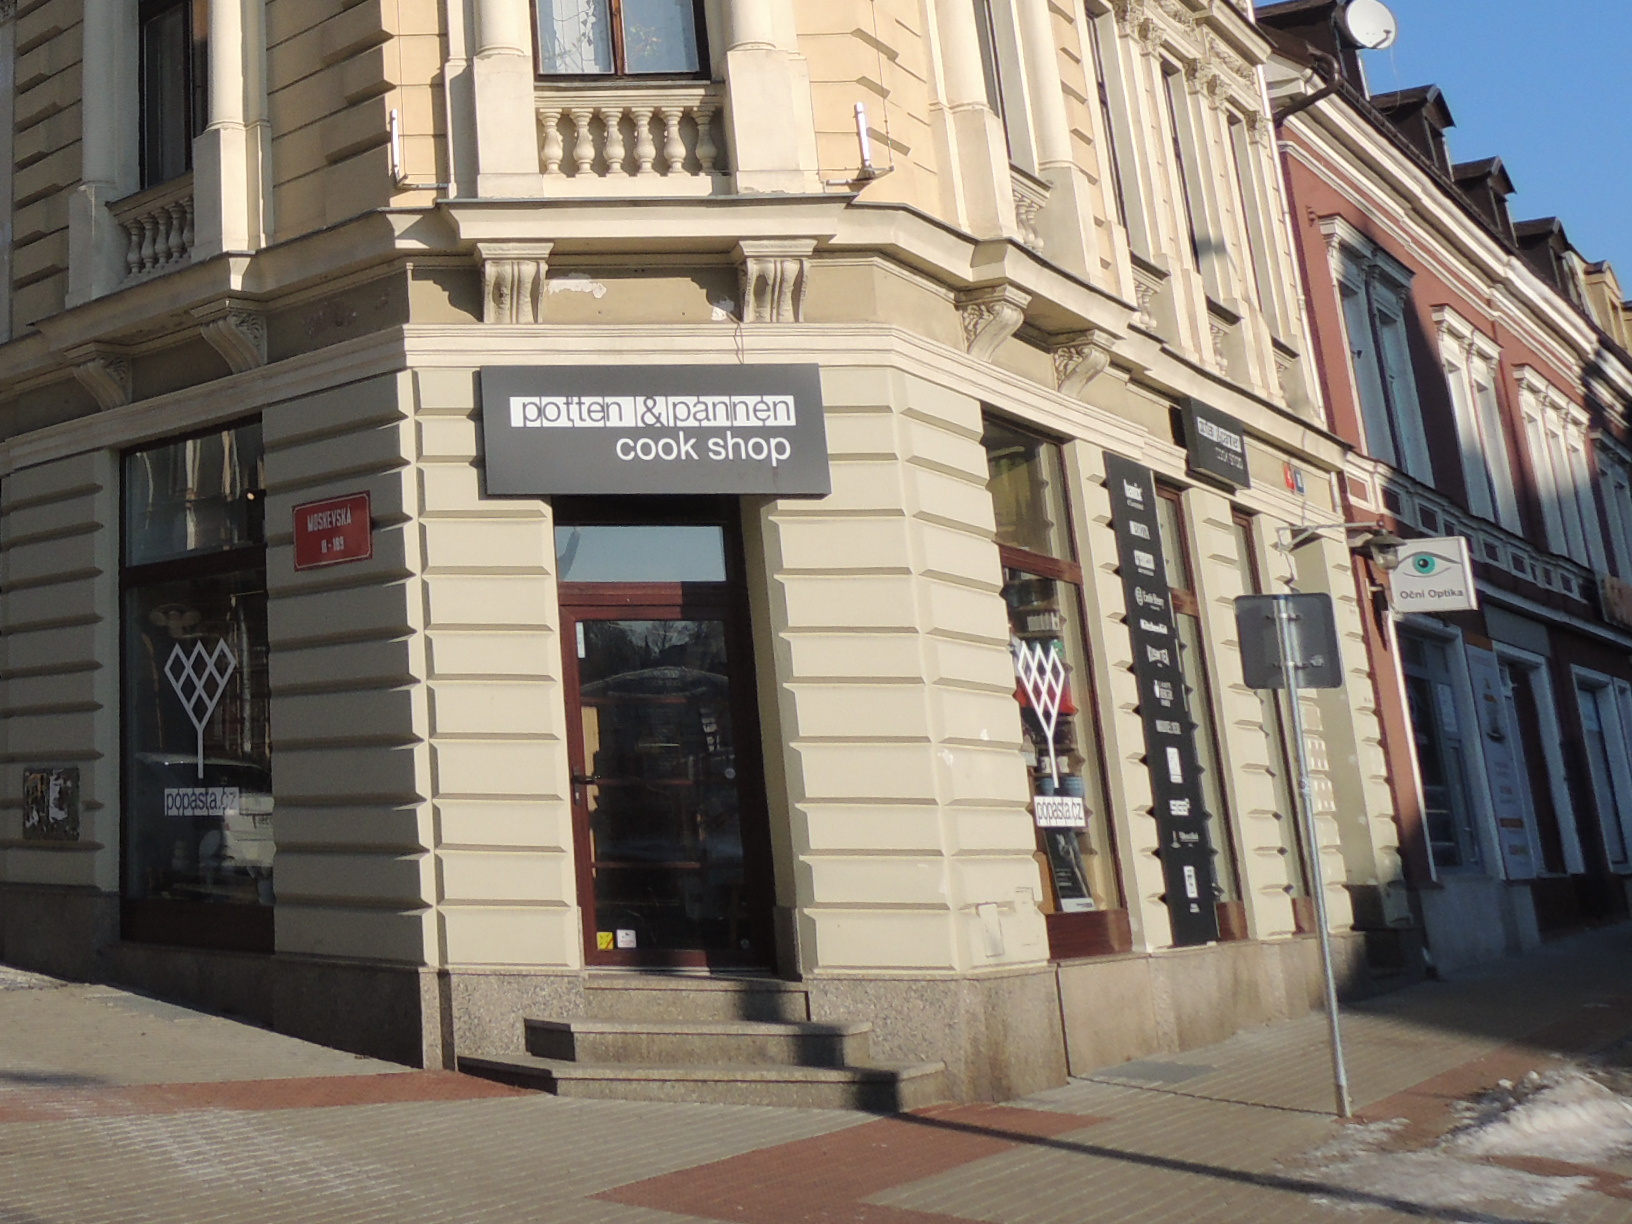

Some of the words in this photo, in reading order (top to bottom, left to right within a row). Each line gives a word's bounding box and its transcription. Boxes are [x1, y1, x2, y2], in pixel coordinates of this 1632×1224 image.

[522, 396, 624, 427] potten
[616, 430, 700, 461] cook
[708, 430, 792, 467] shop
[307, 504, 352, 532] MOSKEVSKÁ
[1428, 589, 1464, 599] Optika
[166, 791, 237, 816] popasta.cz
[1036, 798, 1084, 826] popasta.cz
